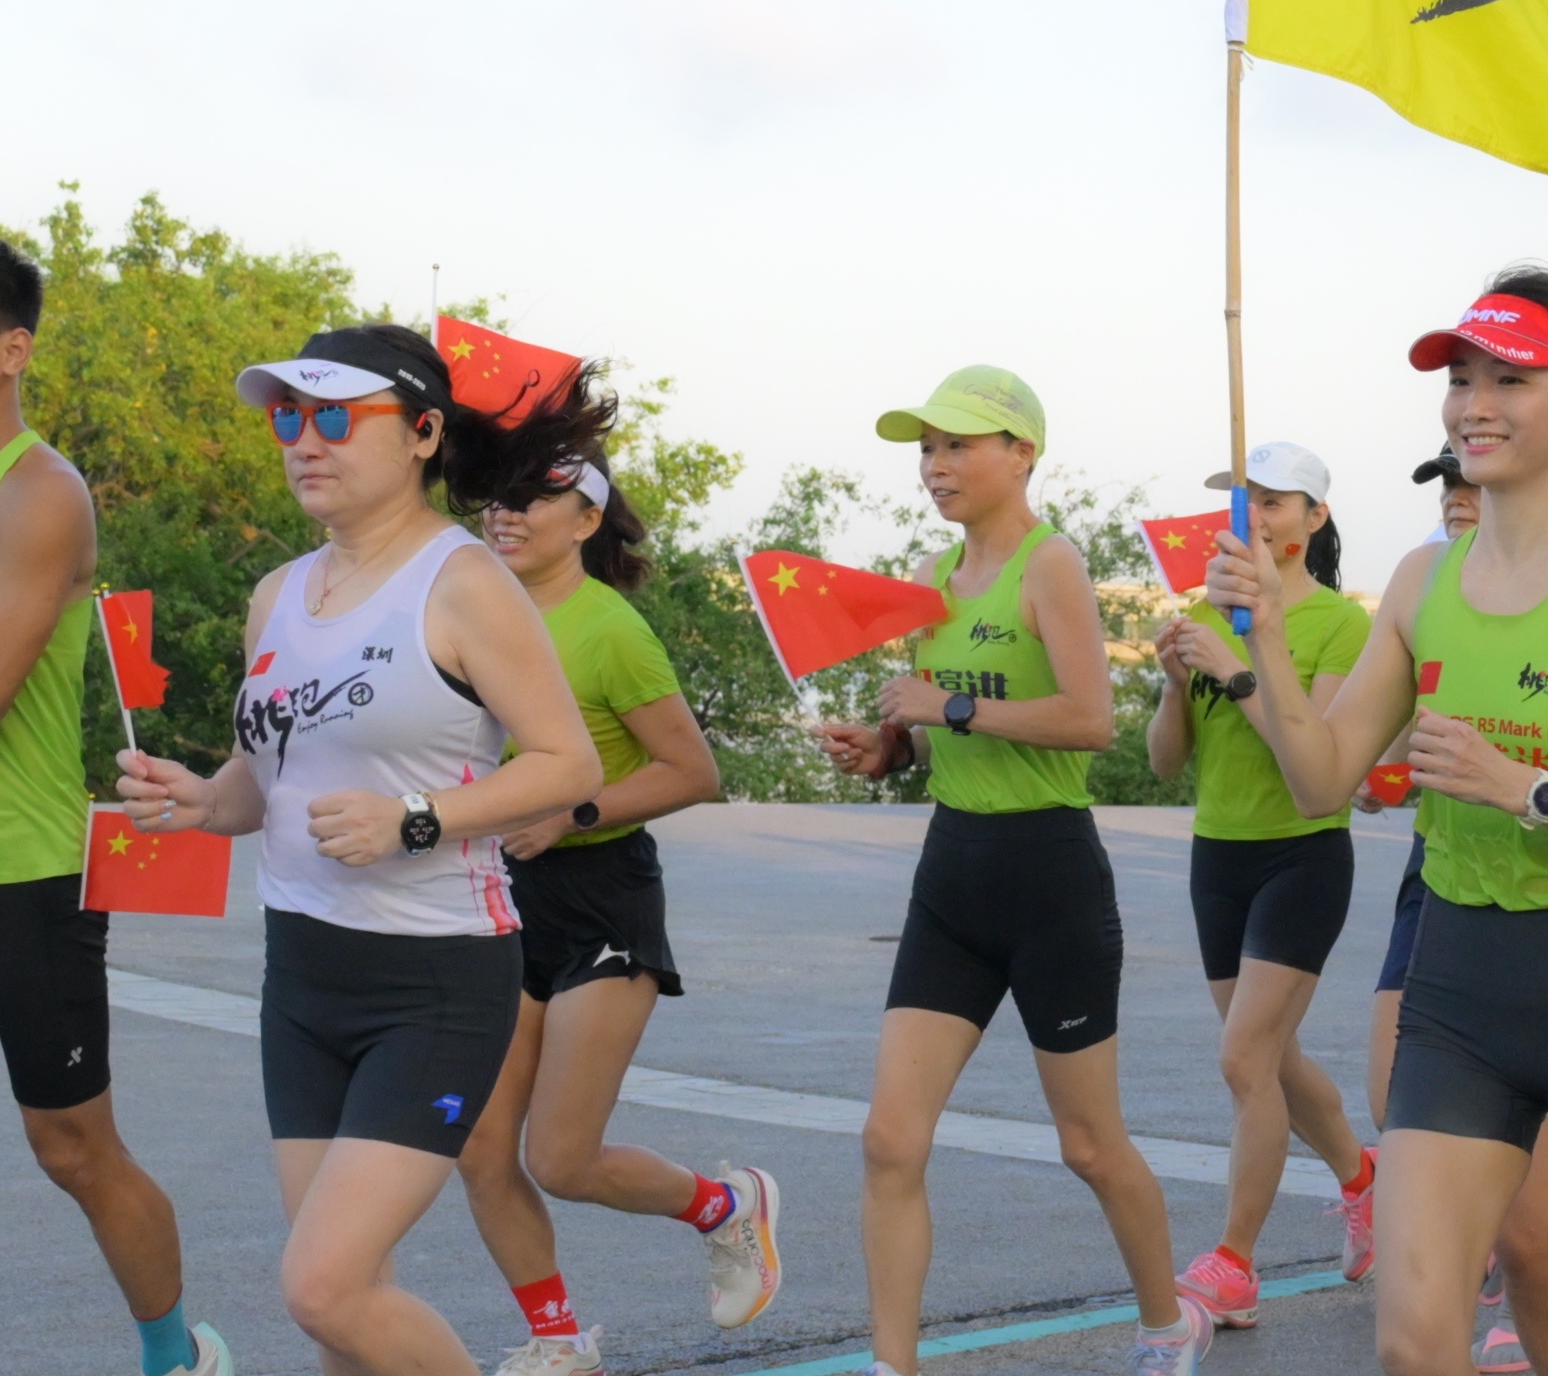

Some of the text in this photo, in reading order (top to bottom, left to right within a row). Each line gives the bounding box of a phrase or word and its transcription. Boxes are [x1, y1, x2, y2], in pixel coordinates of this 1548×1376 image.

[361, 646, 394, 664] 深圳
[297, 709, 354, 734] Enjoy Running
[1478, 717, 1496, 733] R5
[1499, 719, 1542, 739] Mark
